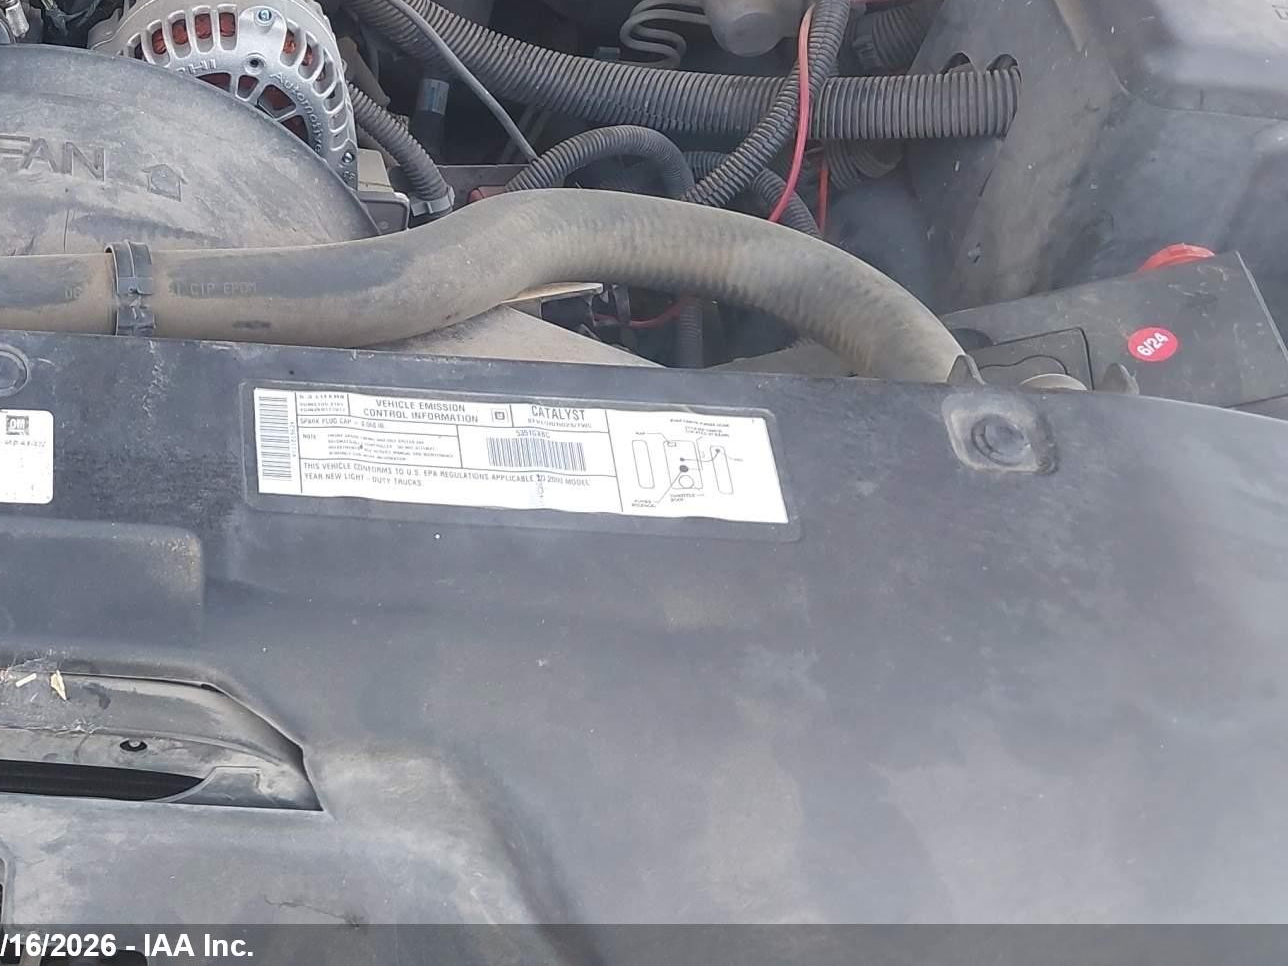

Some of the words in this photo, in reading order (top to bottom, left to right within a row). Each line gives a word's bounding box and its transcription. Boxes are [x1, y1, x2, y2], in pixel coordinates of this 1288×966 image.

[1137, 332, 1169, 356] 6/24
[376, 399, 415, 409] VEHICLE
[419, 402, 465, 412] EMISSION
[531, 405, 585, 421] CATALYST
[363, 408, 408, 419] CONTROL
[412, 412, 478, 423] INFORMATION
[322, 462, 352, 471] VEHICLE
